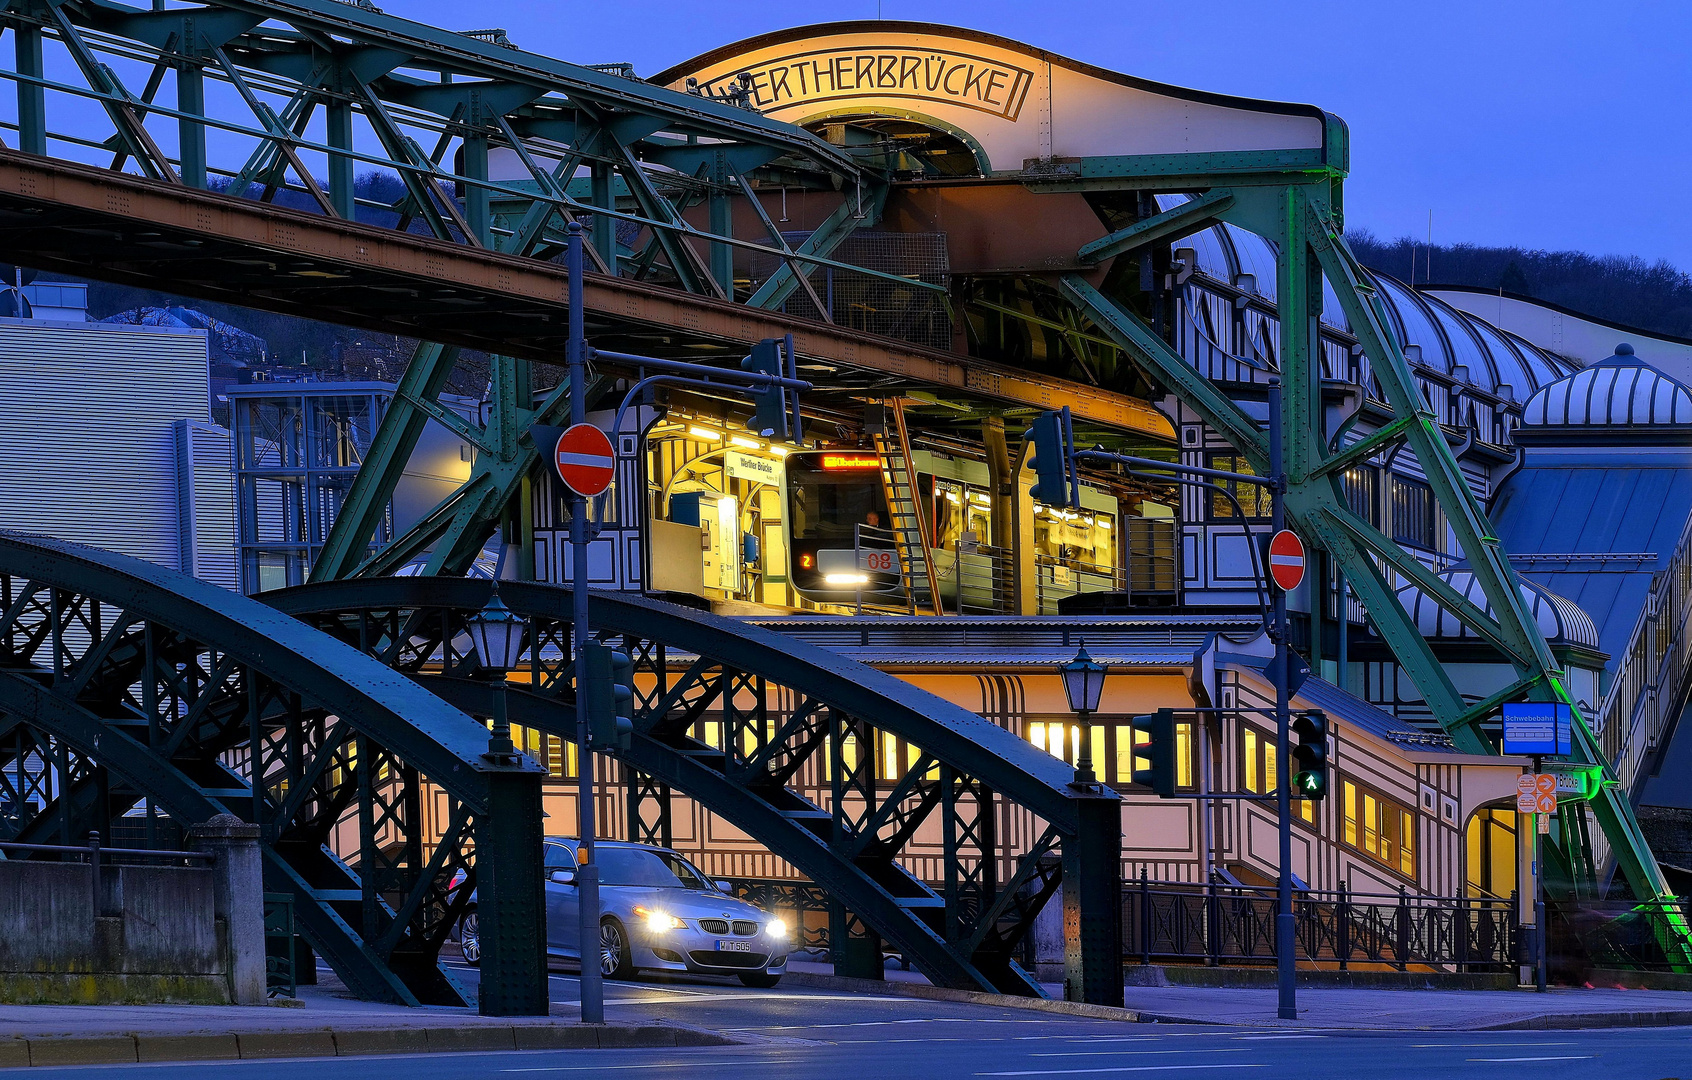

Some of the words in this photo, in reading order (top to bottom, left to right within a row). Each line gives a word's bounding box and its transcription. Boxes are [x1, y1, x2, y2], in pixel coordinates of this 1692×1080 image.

[740, 458, 756, 470] Werther
[758, 461, 772, 474] Brücke
[803, 556, 811, 567] 2
[868, 553, 892, 570] 08
[1560, 774, 1578, 788] Brücke
